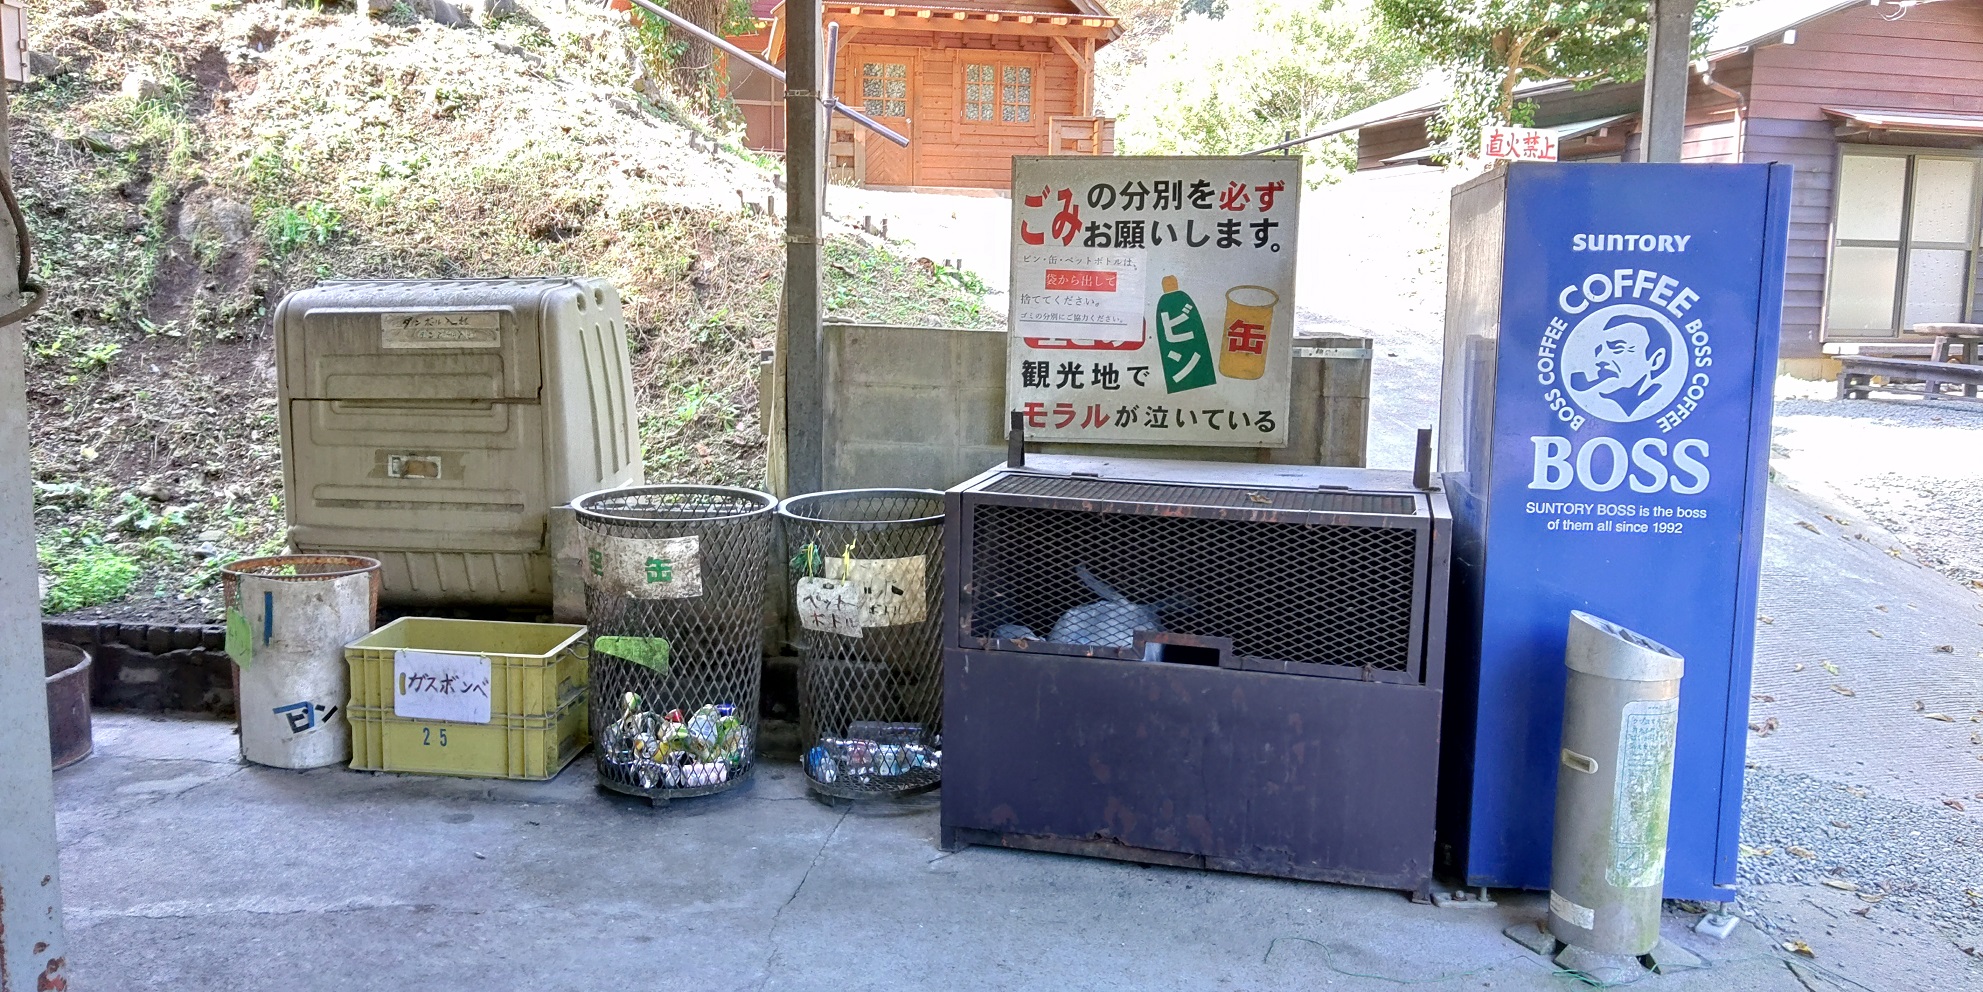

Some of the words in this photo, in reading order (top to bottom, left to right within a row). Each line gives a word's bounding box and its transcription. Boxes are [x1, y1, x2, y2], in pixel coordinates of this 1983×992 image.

[1486, 128, 1557, 160] 直火禁止
[1083, 218, 1280, 252] お願いします。
[1572, 233, 1691, 252] SUNTORY
[1046, 273, 1117, 287] 袋から出して
[1559, 268, 1700, 319] COFFEE
[1020, 293, 1100, 307] 捨ててください。
[1020, 312, 1123, 323] ゴミの分別にご協力ください。
[1160, 303, 1201, 383] ビン
[1227, 319, 1267, 355] 缶
[1537, 316, 1568, 385] COFFEE
[1685, 318, 1712, 367] BOSS
[1021, 360, 1150, 390] 観光地で
[1023, 402, 1277, 433] モラルが泣いている
[1544, 388, 1586, 431] BOSS
[1656, 372, 1710, 433] COFFEE
[1527, 436, 1710, 495] BOSS
[1526, 502, 1594, 515] SUNTORY
[1597, 504, 1636, 517] BOSS
[1639, 505, 1650, 517] is
[1653, 505, 1673, 518] the
[1676, 506, 1707, 519] boss
[1547, 519, 1559, 531] of
[1562, 520, 1594, 532] them
[1597, 520, 1612, 532] all
[1615, 521, 1649, 533] since
[1652, 522, 1683, 534] 1992
[407, 672, 490, 698] ガスボンベ
